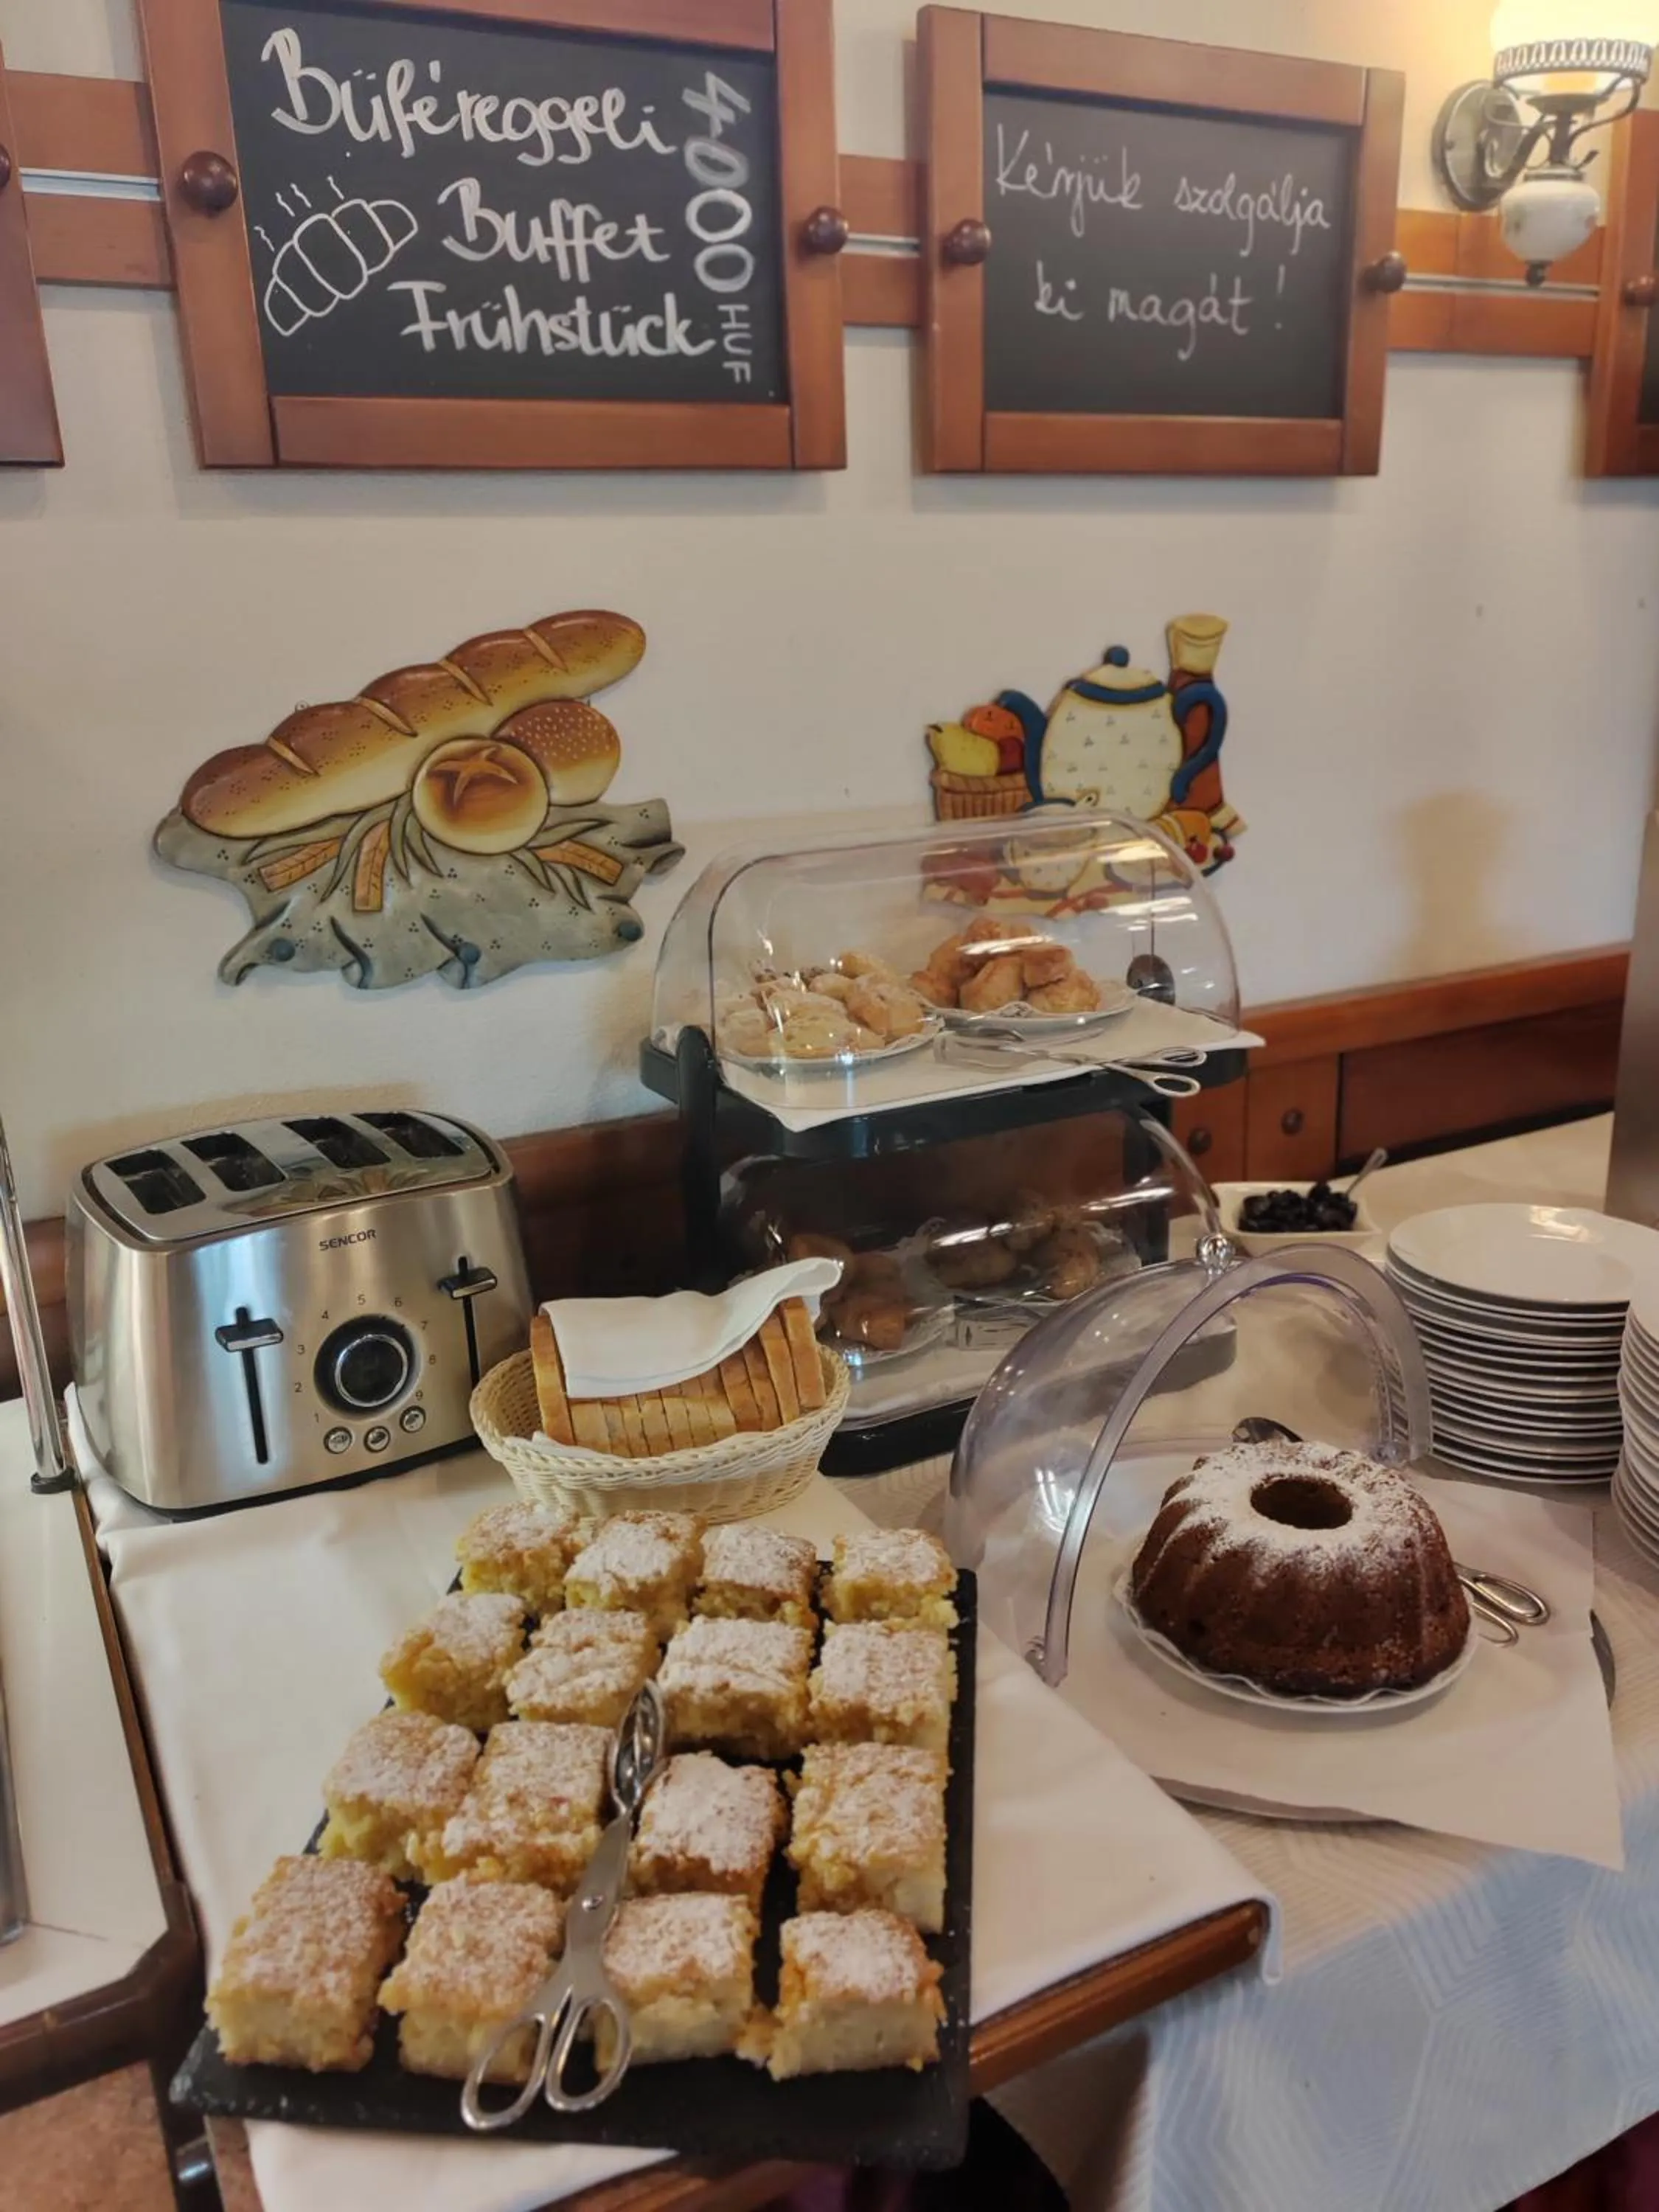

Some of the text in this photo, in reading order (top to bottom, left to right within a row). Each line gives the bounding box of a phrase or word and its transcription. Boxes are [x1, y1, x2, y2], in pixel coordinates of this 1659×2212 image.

[438, 177, 669, 282] Buffet
[682, 72, 755, 384] 4000 HUF
[1034, 260, 1084, 321] ki
[387, 280, 716, 357] Frühstück
[319, 1228, 377, 1251] SENCOR
[358, 1294, 366, 1305] 5
[394, 1297, 403, 1307] 6
[321, 1310, 329, 1321] 4
[421, 1320, 429, 1330] 7
[298, 1344, 305, 1354] 3
[428, 1354, 437, 1365] 8
[295, 1382, 302, 1393] 2
[415, 1390, 423, 1401] 9
